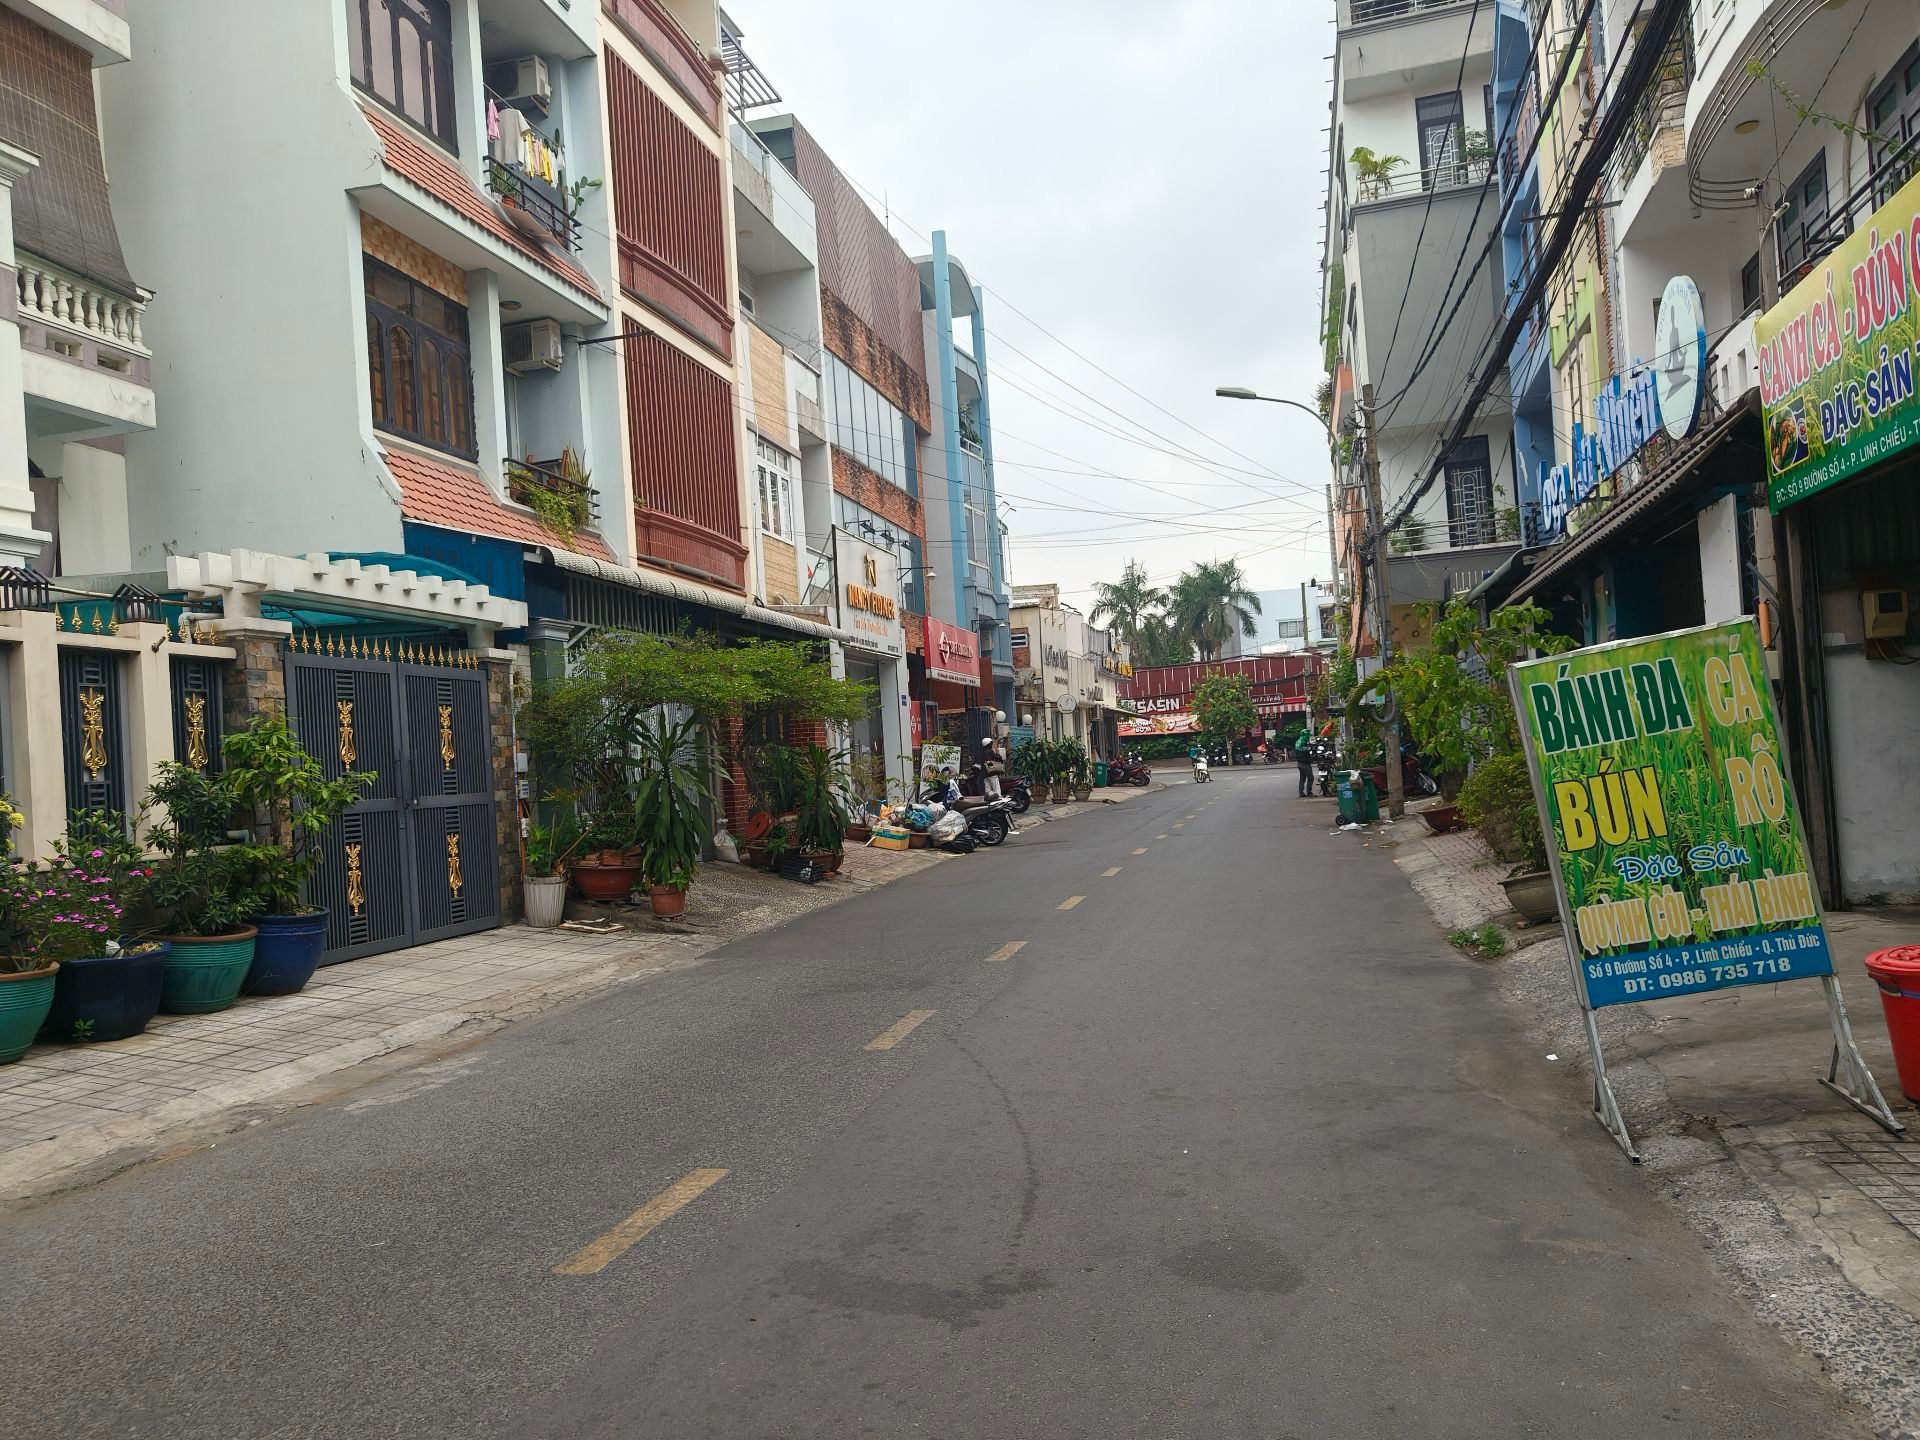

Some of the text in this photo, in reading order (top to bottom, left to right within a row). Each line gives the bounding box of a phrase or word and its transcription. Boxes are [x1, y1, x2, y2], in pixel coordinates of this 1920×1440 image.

[1758, 310, 1810, 409] CANH
[1811, 268, 1842, 373] CÁ
[1852, 227, 1908, 343] BÚN
[1820, 343, 1914, 447] ĐẶC SẢN
[1787, 475, 1798, 499] SỐ
[1829, 454, 1840, 478] SỐ
[1859, 440, 1879, 463] LINH
[1879, 421, 1907, 453] CHIỂU
[1136, 697, 1180, 713] SASIN
[1531, 656, 1695, 755] BÁNH ĐA
[1704, 632, 1764, 727] CÁ
[1554, 756, 1669, 853] BÚN
[1725, 732, 1785, 827] RÔ
[1614, 841, 1751, 885] Đặc Sản
[1576, 889, 1652, 956] QUỲNH
[1649, 884, 1693, 940] CÔI
[1700, 873, 1757, 932] THÁI
[1754, 868, 1816, 925] BÌNH
[1589, 959, 1604, 979] Số
[1605, 961, 1613, 976] 9
[1614, 955, 1648, 977] Đường
[1648, 951, 1664, 970] Số
[1665, 954, 1673, 967] 4
[1682, 949, 1695, 965] P.
[1698, 946, 1720, 964] Linh
[1721, 940, 1754, 961] Chiểu
[1762, 939, 1774, 955] Q.
[1775, 935, 1797, 953] Thủ
[1797, 933, 1821, 950] Đức
[1624, 957, 1791, 994] ĐT: 0986 735 718
